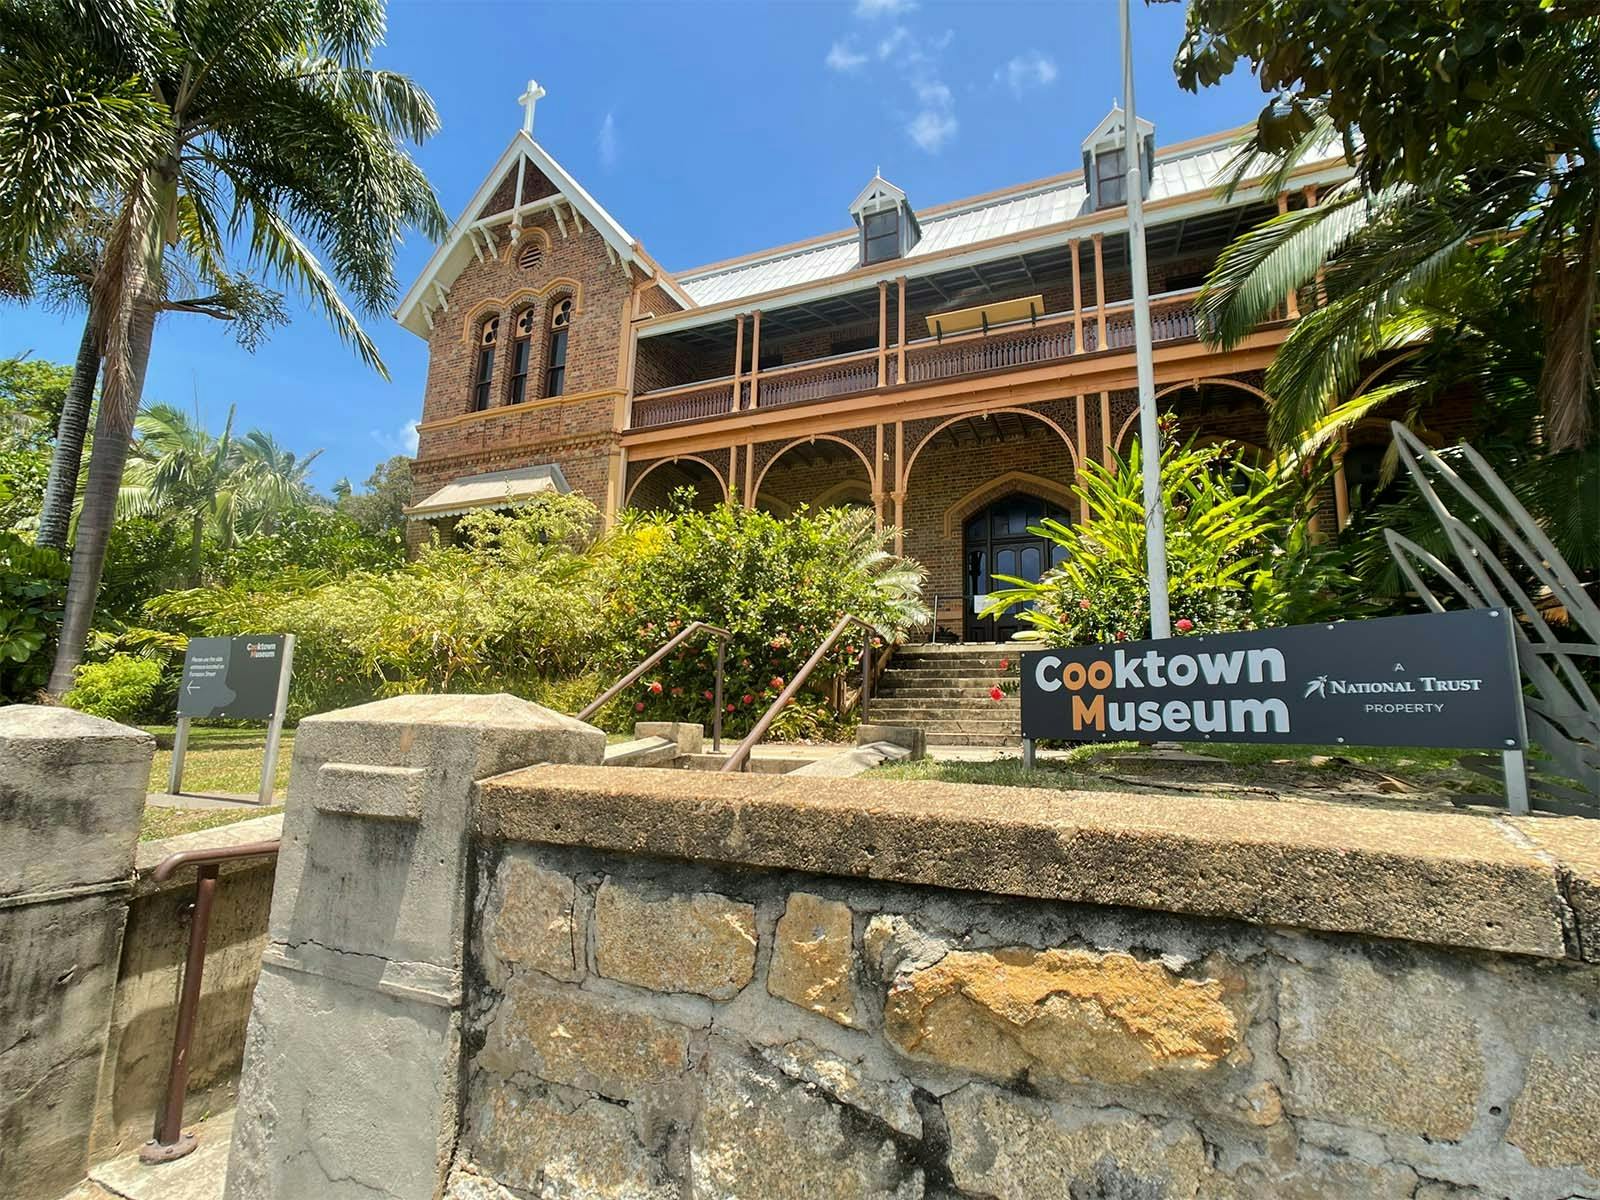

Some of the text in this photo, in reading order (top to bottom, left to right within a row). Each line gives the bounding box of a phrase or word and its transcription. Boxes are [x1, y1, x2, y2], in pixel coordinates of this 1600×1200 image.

[246, 643, 276, 651] Cooktown
[1035, 646, 1287, 692] Cooktown
[1393, 663, 1406, 672] A
[1365, 703, 1445, 713] PROPERTY
[1071, 694, 1291, 733] Museum
